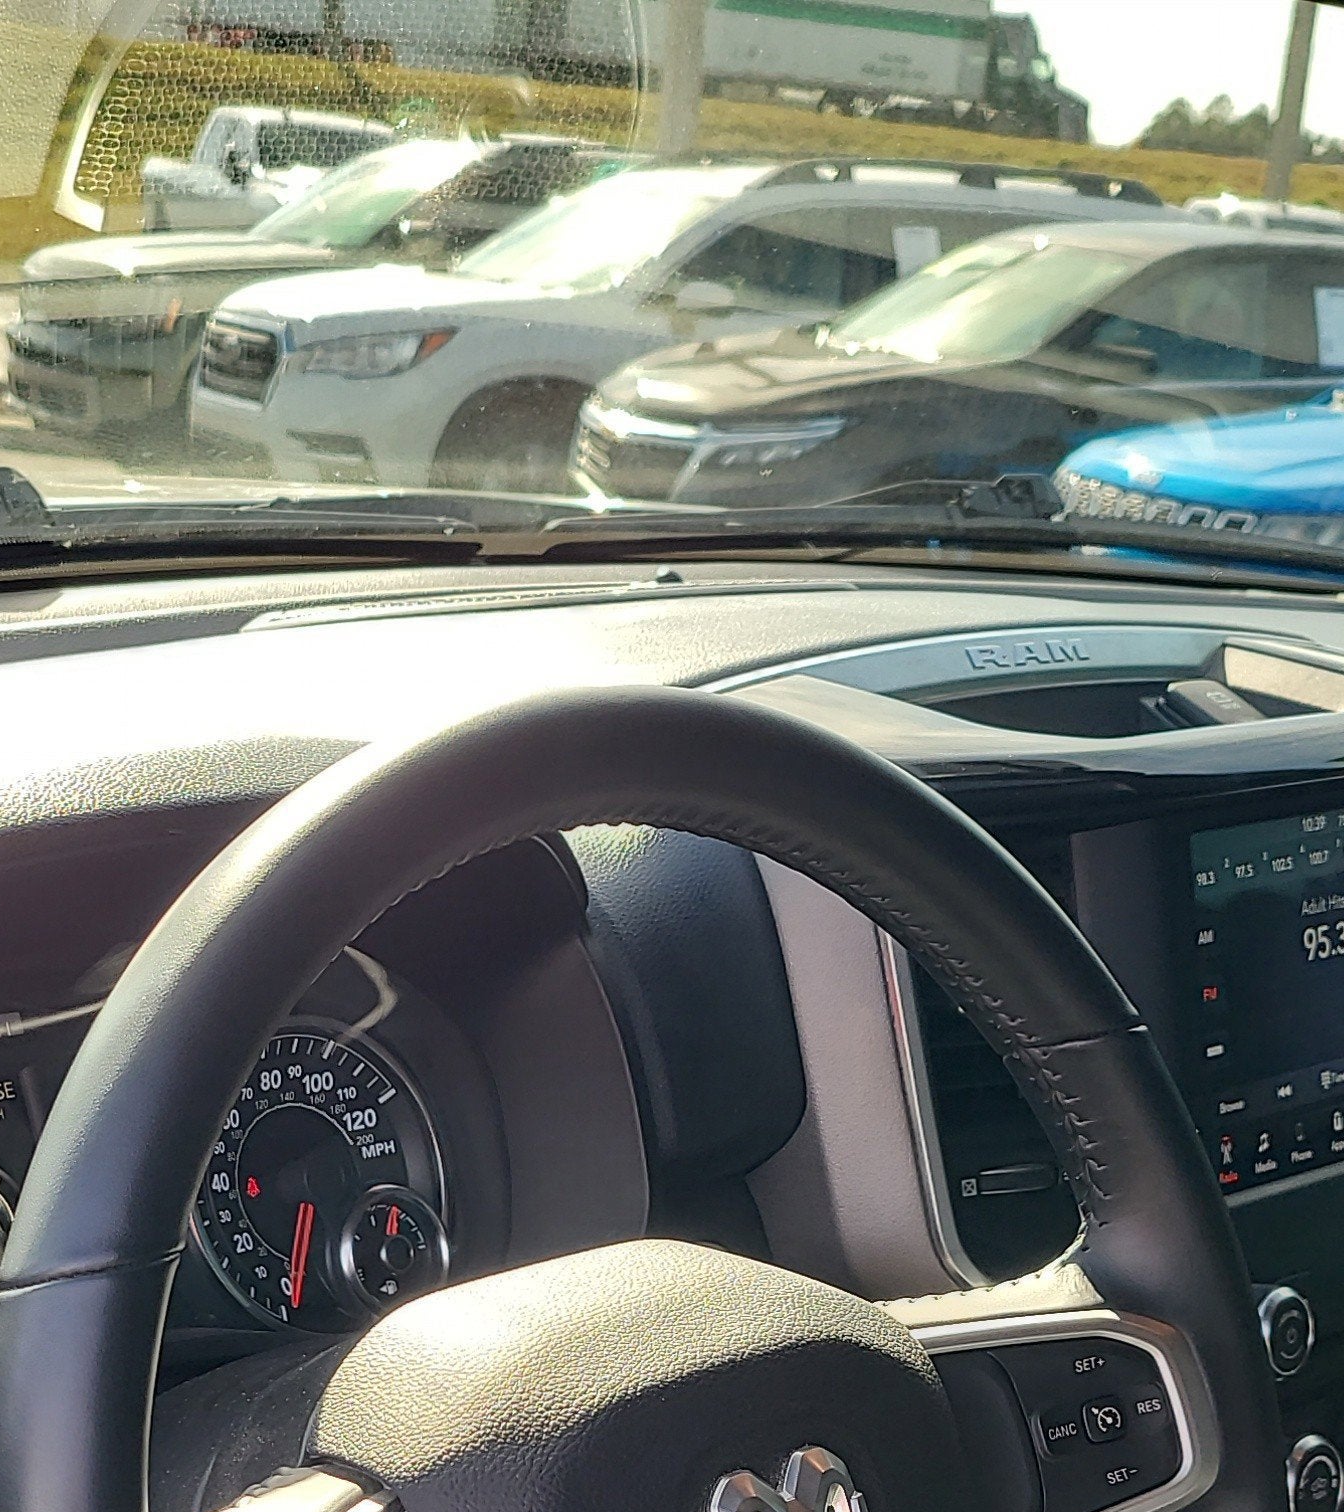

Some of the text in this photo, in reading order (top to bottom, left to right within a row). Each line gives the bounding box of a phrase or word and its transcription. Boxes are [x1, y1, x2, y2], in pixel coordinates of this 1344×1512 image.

[965, 638, 1090, 671] RAM
[1198, 928, 1215, 945] AM
[260, 1070, 282, 1091] 80
[287, 1065, 302, 1079] 90
[302, 1071, 334, 1094] 100
[241, 1087, 253, 1101] 70
[280, 1091, 295, 1101] 140
[309, 1093, 326, 1104] 160
[336, 1086, 357, 1101] 110
[255, 1098, 269, 1110] 120
[342, 1108, 377, 1132] 120
[356, 1133, 374, 1146] 200
[361, 1139, 396, 1159] MPH
[212, 1172, 230, 1192] 40
[219, 1209, 232, 1223] 30
[233, 1232, 254, 1254] 20
[255, 1265, 268, 1279] 10
[280, 1277, 293, 1296] 0
[1137, 1399, 1161, 1416] RES
[1048, 1422, 1077, 1441] CANC
